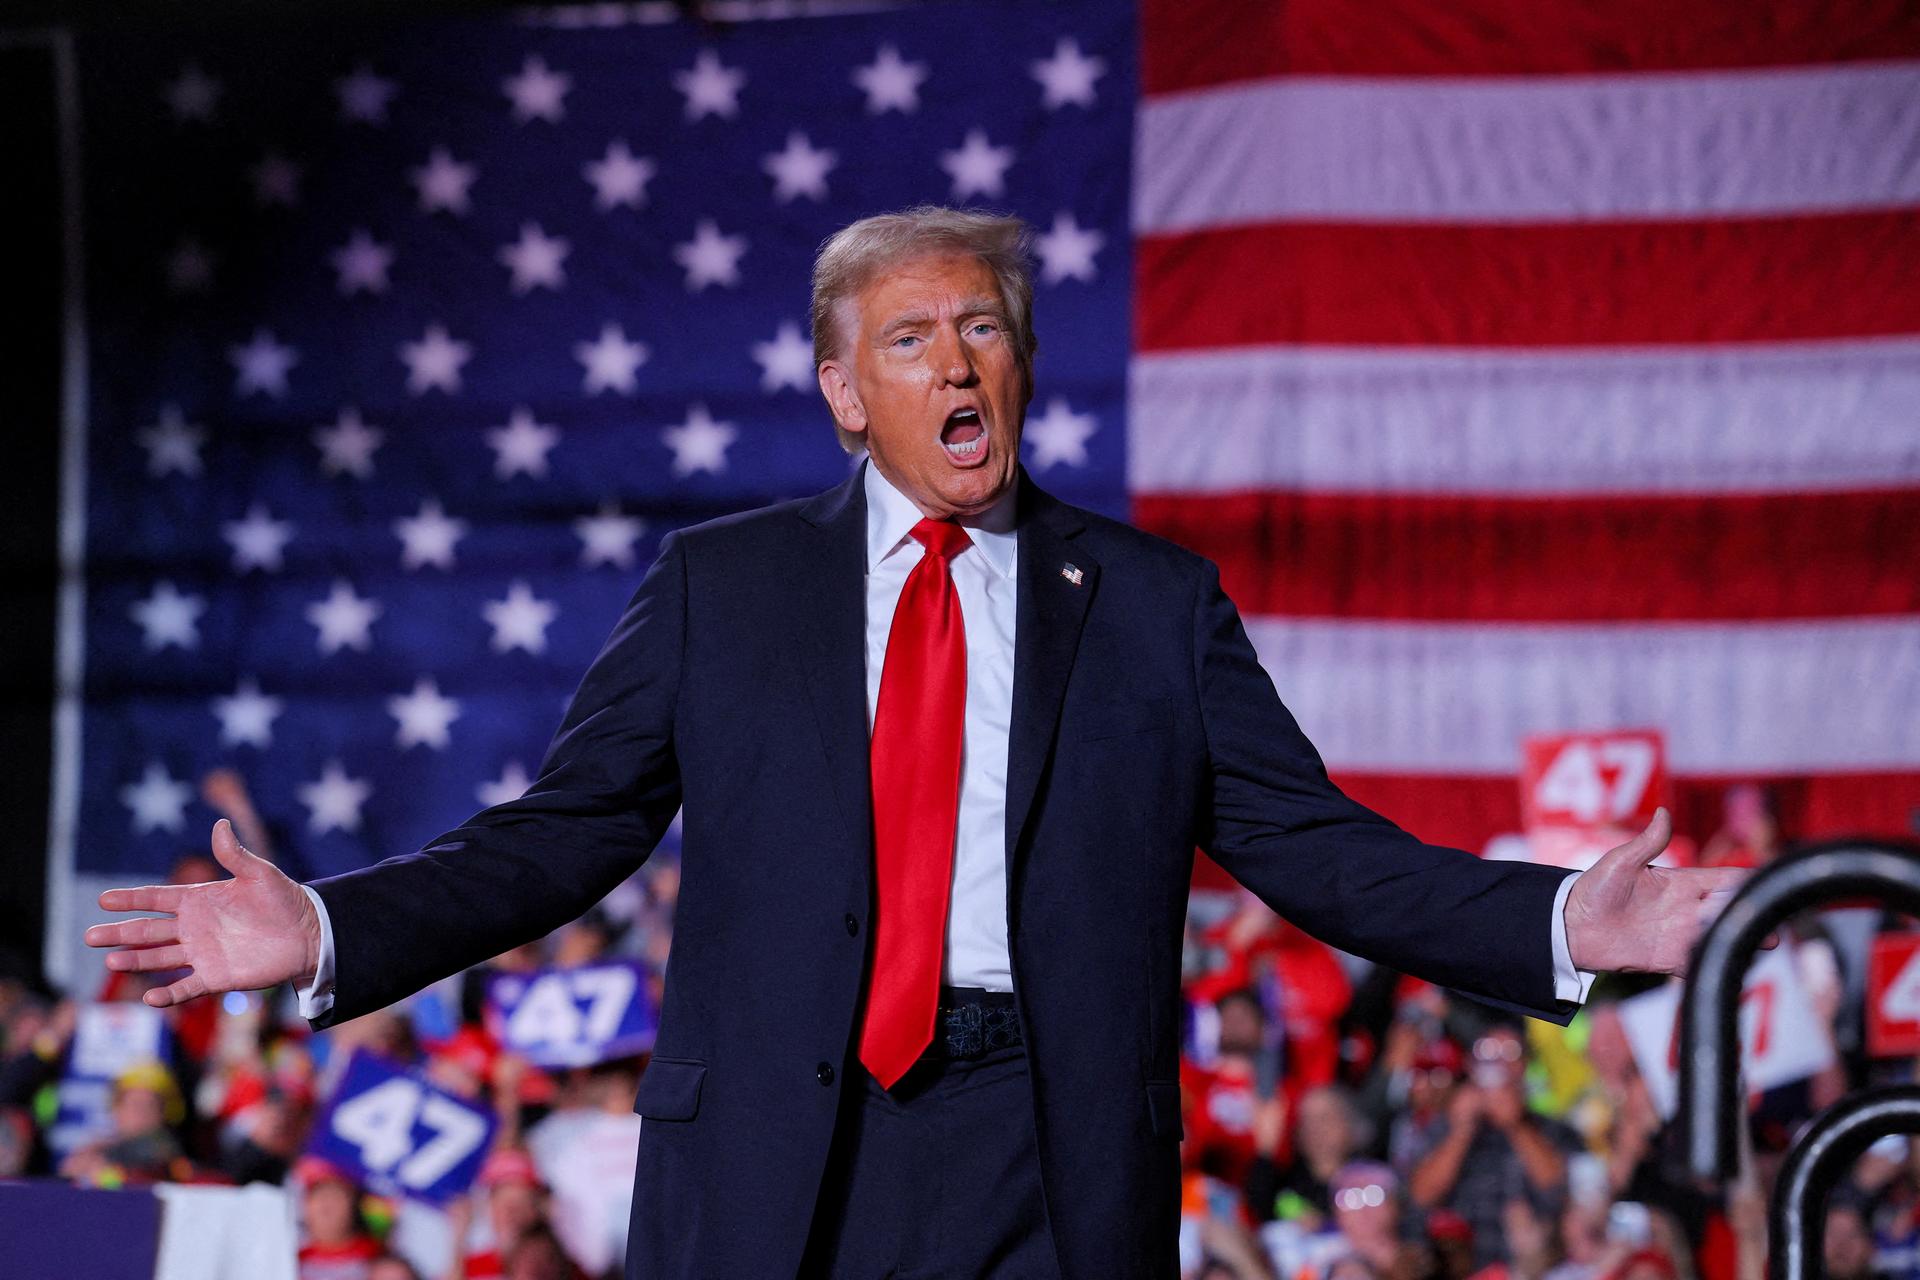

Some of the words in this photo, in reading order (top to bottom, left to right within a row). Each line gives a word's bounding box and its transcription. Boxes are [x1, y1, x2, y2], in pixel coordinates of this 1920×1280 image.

[1538, 741, 1653, 821] 47
[508, 965, 637, 1047] 47
[332, 1077, 487, 1190] 47
